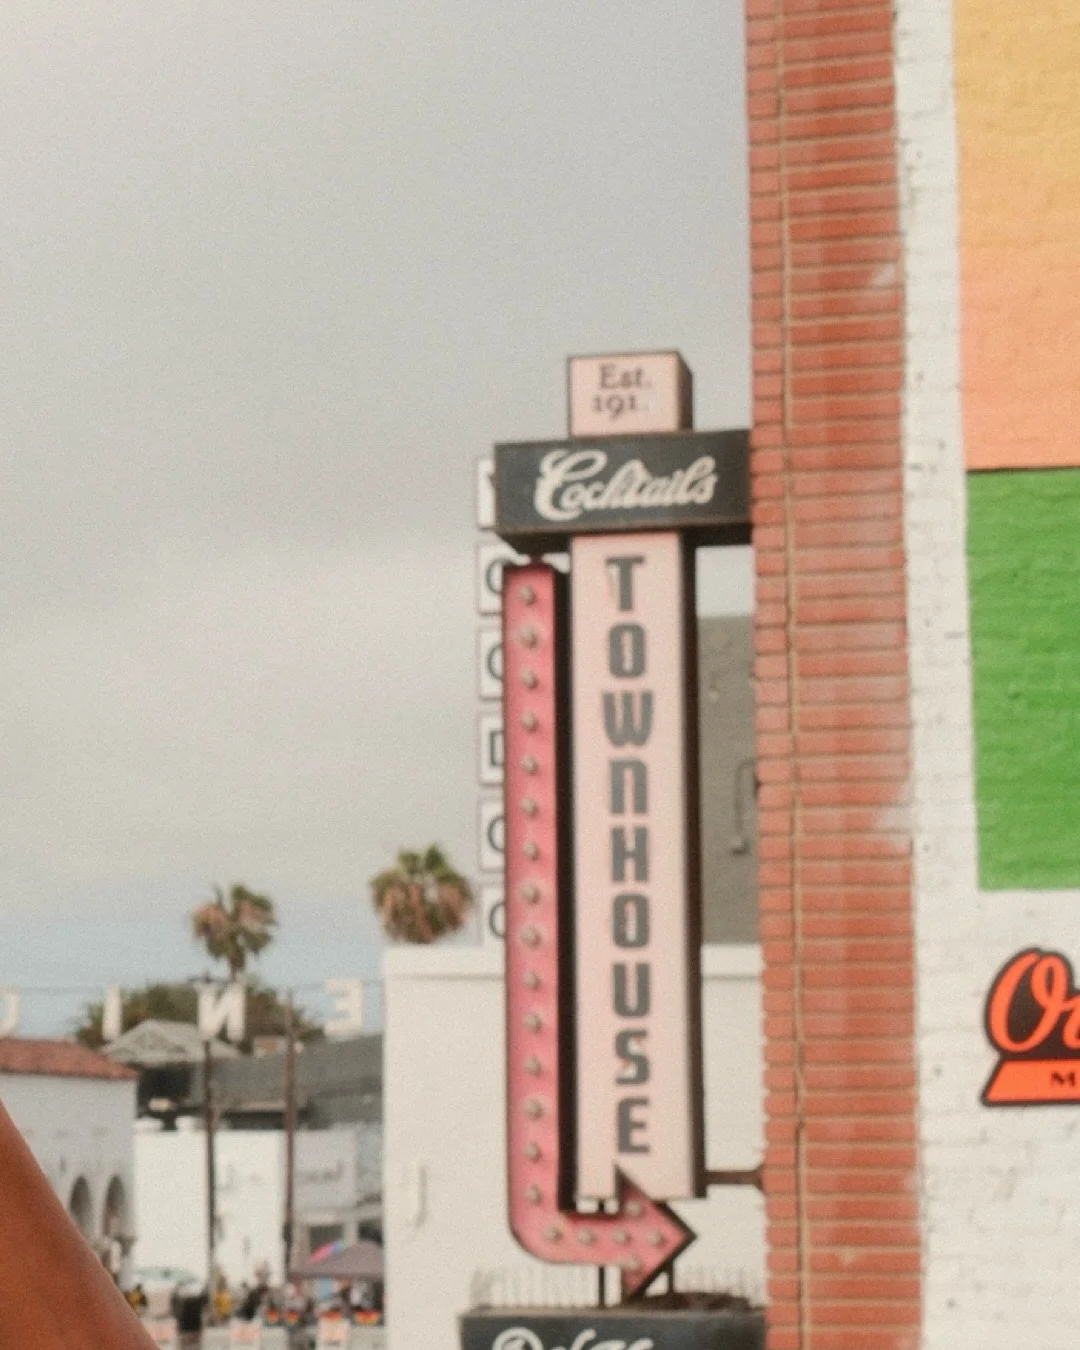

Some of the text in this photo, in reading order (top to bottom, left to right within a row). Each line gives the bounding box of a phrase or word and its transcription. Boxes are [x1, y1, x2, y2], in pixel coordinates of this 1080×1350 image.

[597, 362, 653, 391] Est.
[533, 449, 719, 522] Cocktails
[601, 554, 654, 1155] TOWNHOUSE
